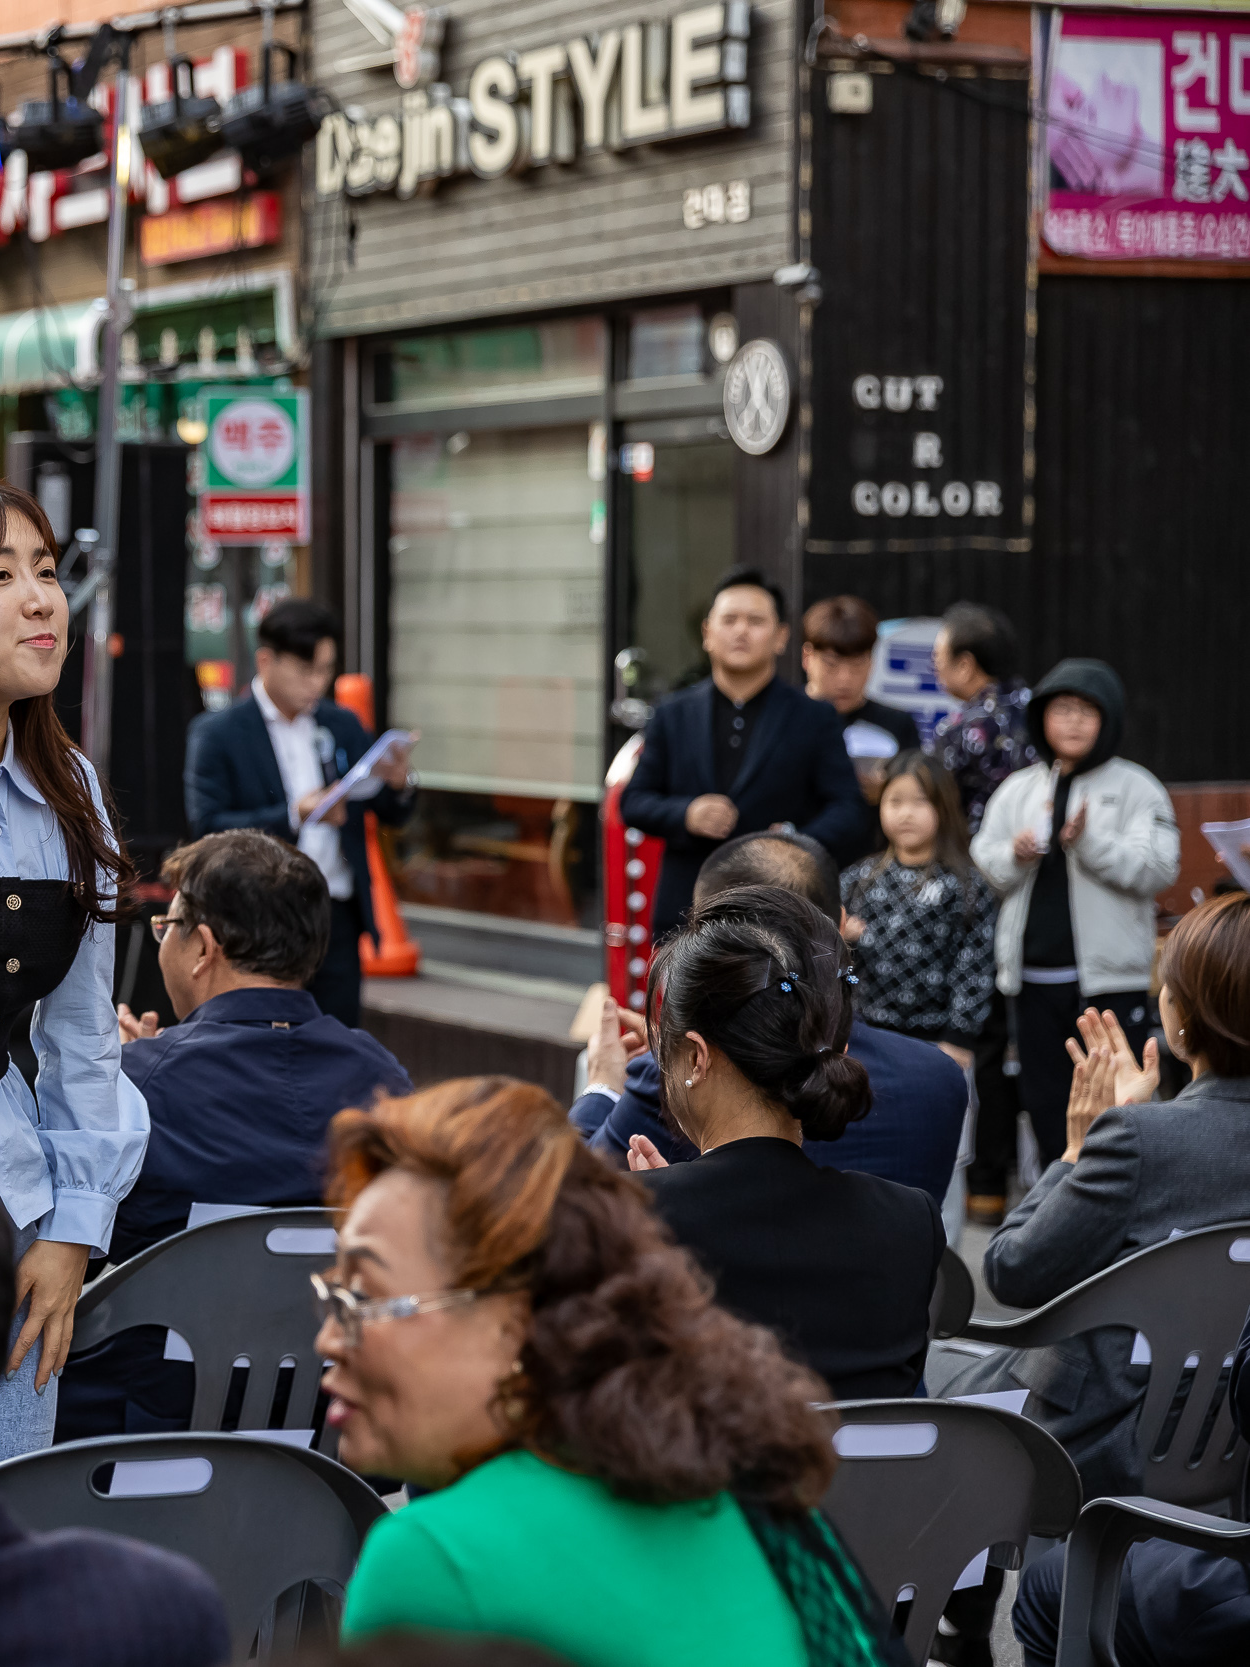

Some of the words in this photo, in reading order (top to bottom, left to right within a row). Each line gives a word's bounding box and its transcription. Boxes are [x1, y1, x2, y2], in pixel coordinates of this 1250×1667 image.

[468, 3, 734, 178] STYLE
[853, 373, 944, 412] CUT
[912, 431, 945, 469] R
[852, 480, 1004, 517] COLOR
